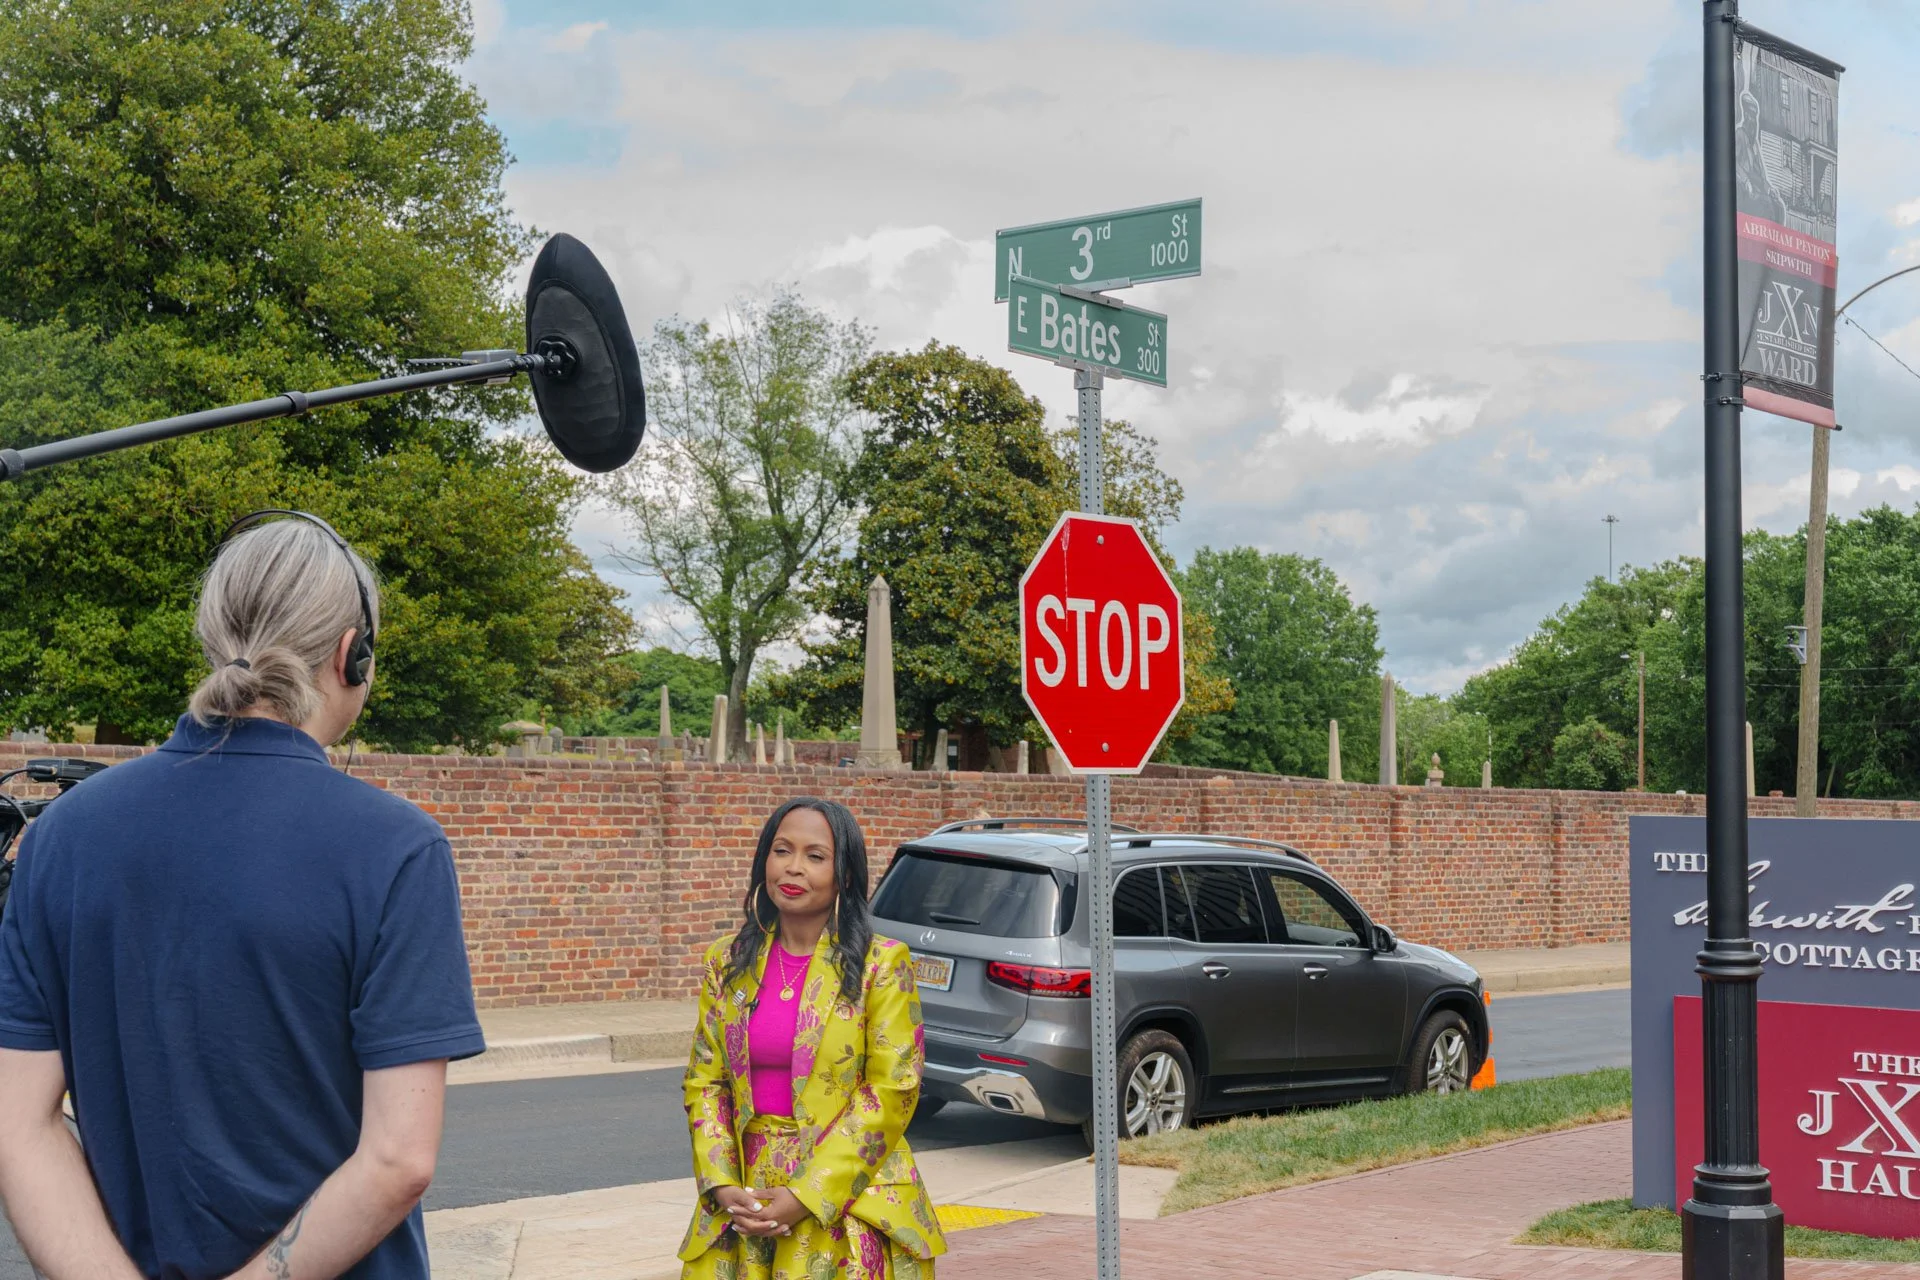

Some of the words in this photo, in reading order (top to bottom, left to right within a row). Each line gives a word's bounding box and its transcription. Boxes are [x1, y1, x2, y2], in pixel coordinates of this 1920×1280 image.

[1008, 246, 1023, 276] N
[1069, 221, 1111, 281] 3rd
[1171, 213, 1188, 238] St
[1150, 239, 1189, 267] 1000
[1743, 220, 1794, 248] ABRAHAM
[1795, 237, 1831, 261] PEYTON
[1765, 248, 1812, 276] SKIPWITH
[1017, 295, 1028, 333] E
[1040, 293, 1121, 365] Bates
[1147, 322, 1160, 348] St
[1758, 281, 1820, 344] JXN
[1137, 347, 1160, 375] 300
[1758, 347, 1817, 386] WARD
[1034, 594, 1171, 690] STOP
[1653, 852, 1708, 872] TH
[1752, 941, 1920, 972] COTTAGE
[1853, 1051, 1920, 1076] THE
